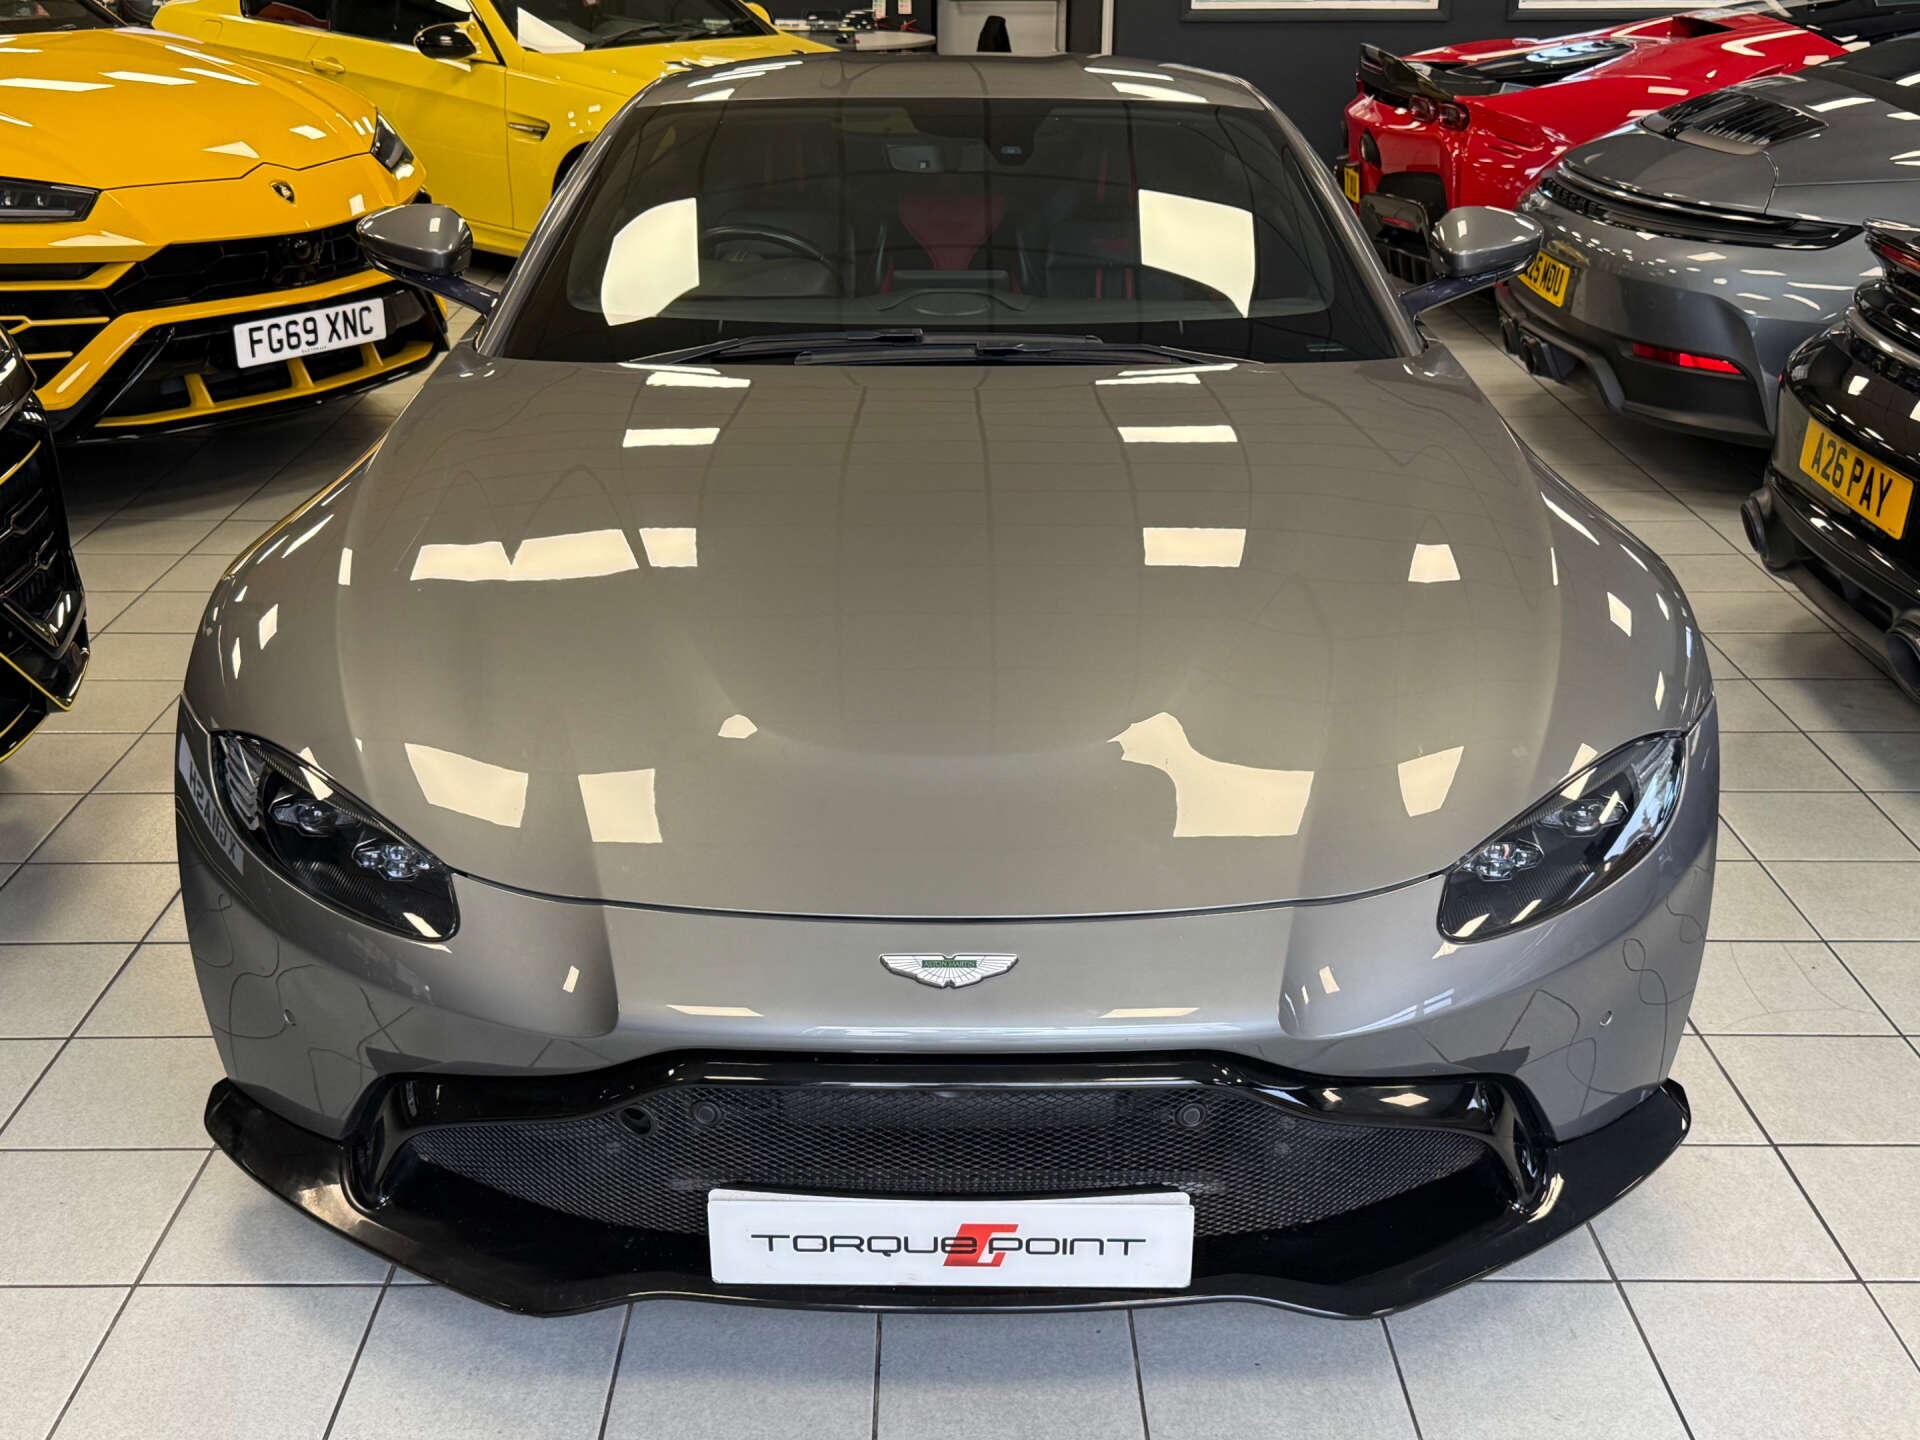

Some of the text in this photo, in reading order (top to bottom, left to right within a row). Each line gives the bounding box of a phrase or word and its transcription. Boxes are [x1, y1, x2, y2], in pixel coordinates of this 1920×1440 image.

[248, 306, 374, 358] FG69 XNC
[1811, 432, 1893, 517] A26 PAY
[751, 1234, 1147, 1257] TORQUE POINT
